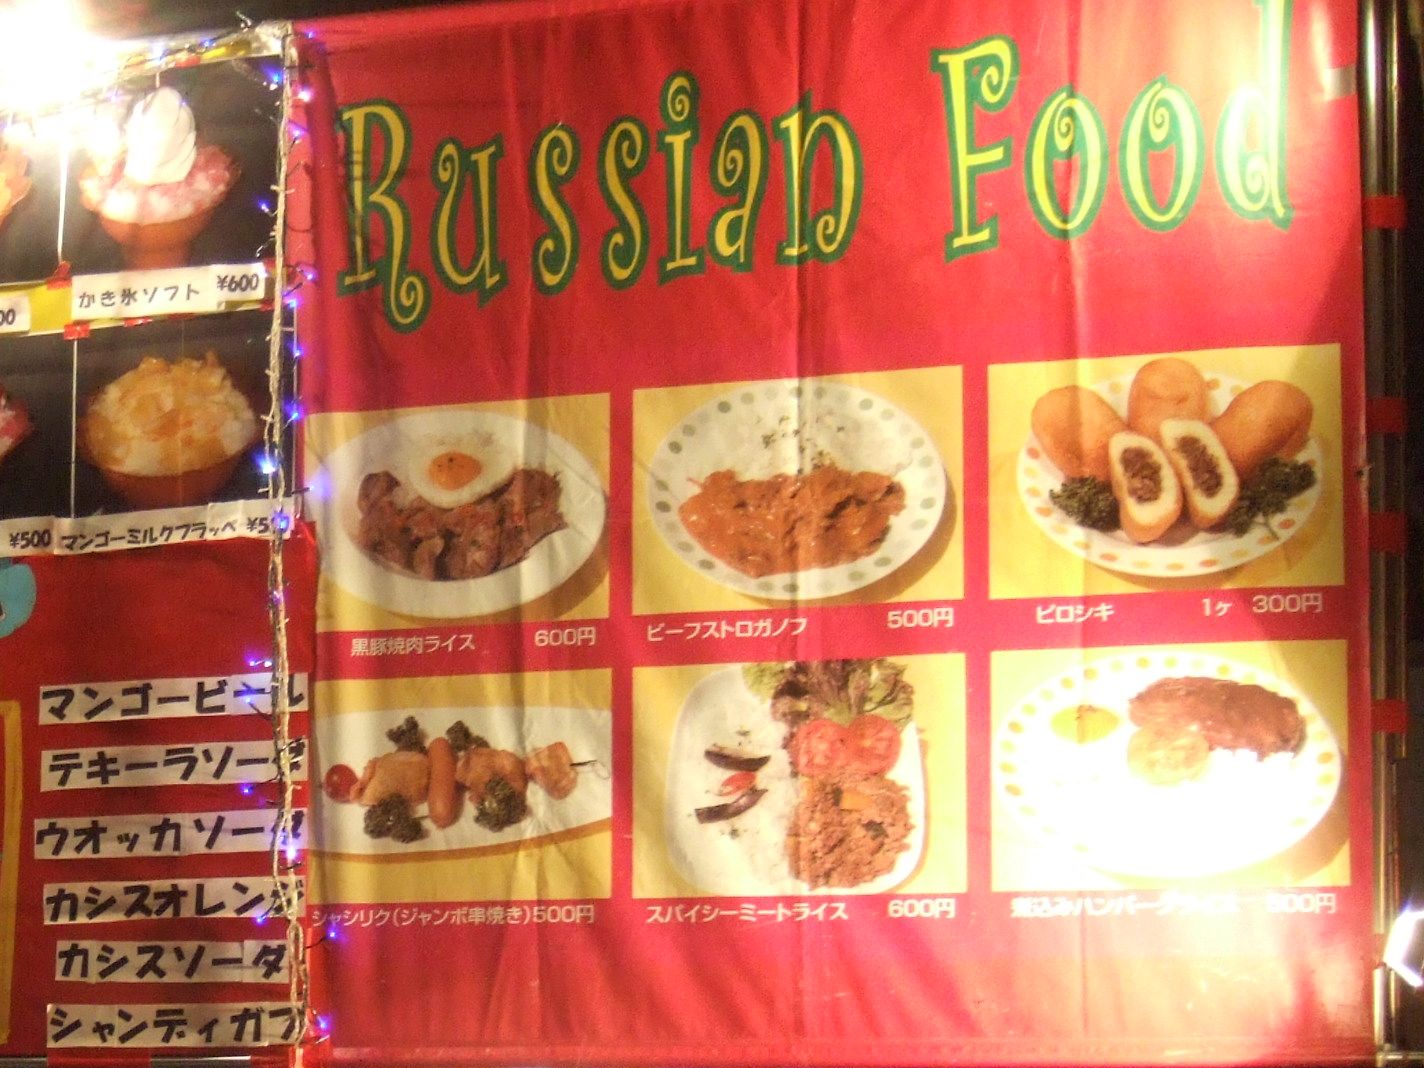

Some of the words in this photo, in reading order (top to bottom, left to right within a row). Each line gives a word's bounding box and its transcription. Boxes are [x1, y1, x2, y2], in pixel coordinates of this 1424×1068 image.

[334, 68, 866, 336] Russian
[929, 0, 1295, 264] Food
[78, 283, 200, 309] かき氷ソフト
[216, 272, 260, 293] ¥600
[9, 528, 52, 551] ¥500
[61, 518, 238, 551] マンゴーミルクフラッペ
[646, 617, 809, 642] ビーフストロガノフ
[887, 607, 955, 630] 500円
[1035, 602, 1115, 625] ピロシキ
[1251, 592, 1324, 615] 300円
[350, 633, 477, 657] 黒豚焼肉ライス
[533, 626, 597, 648] 600円
[645, 902, 849, 925] スパイシーミートライス
[887, 897, 957, 920] 600円
[57, 942, 289, 979] カシスソーダ
